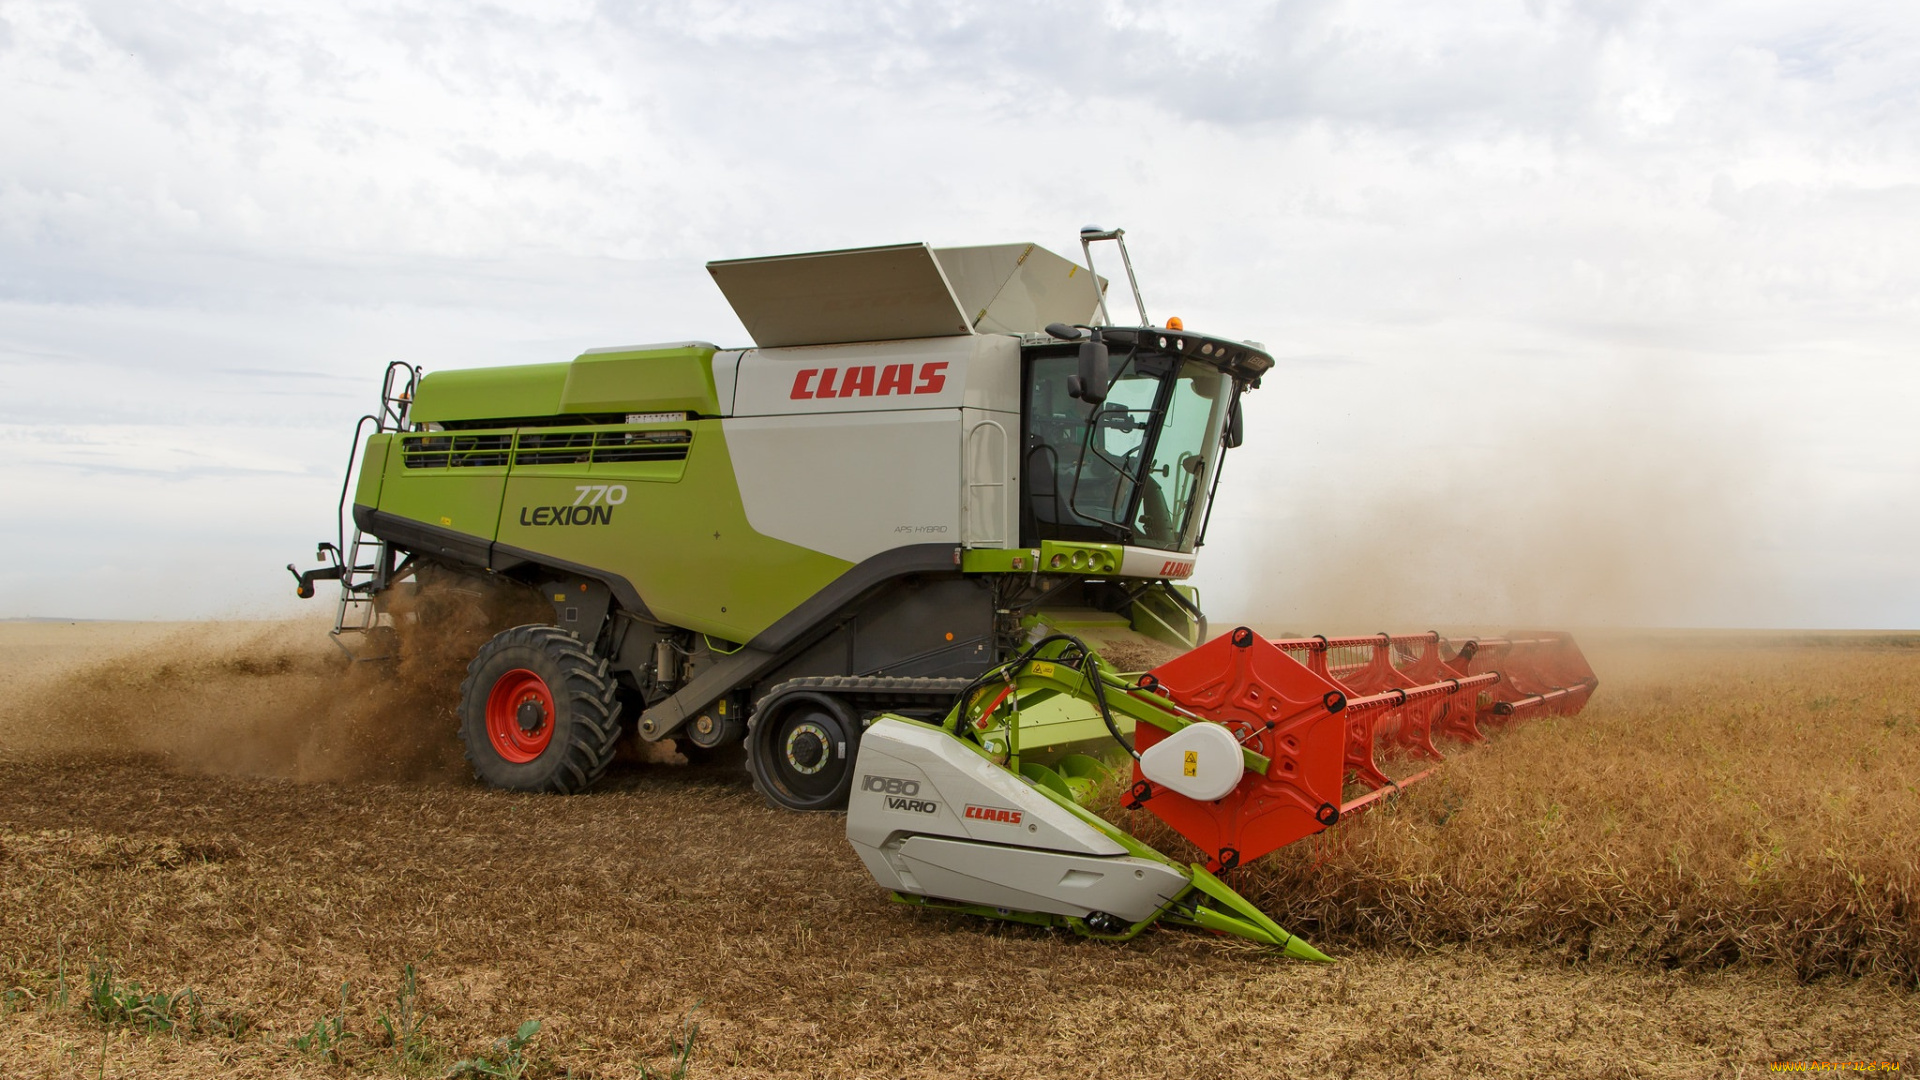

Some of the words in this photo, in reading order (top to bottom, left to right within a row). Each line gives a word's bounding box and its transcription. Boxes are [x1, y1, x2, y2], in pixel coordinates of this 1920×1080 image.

[790, 361, 949, 400] CLAAS
[573, 484, 628, 506] 770
[519, 505, 614, 527] LEXION
[893, 525, 912, 534] APS
[914, 525, 948, 534] HYBRID
[1159, 561, 1192, 578] CLAAS
[862, 775, 921, 797] 1080
[888, 797, 937, 814] VARIO
[965, 806, 1022, 825] CLAAS
